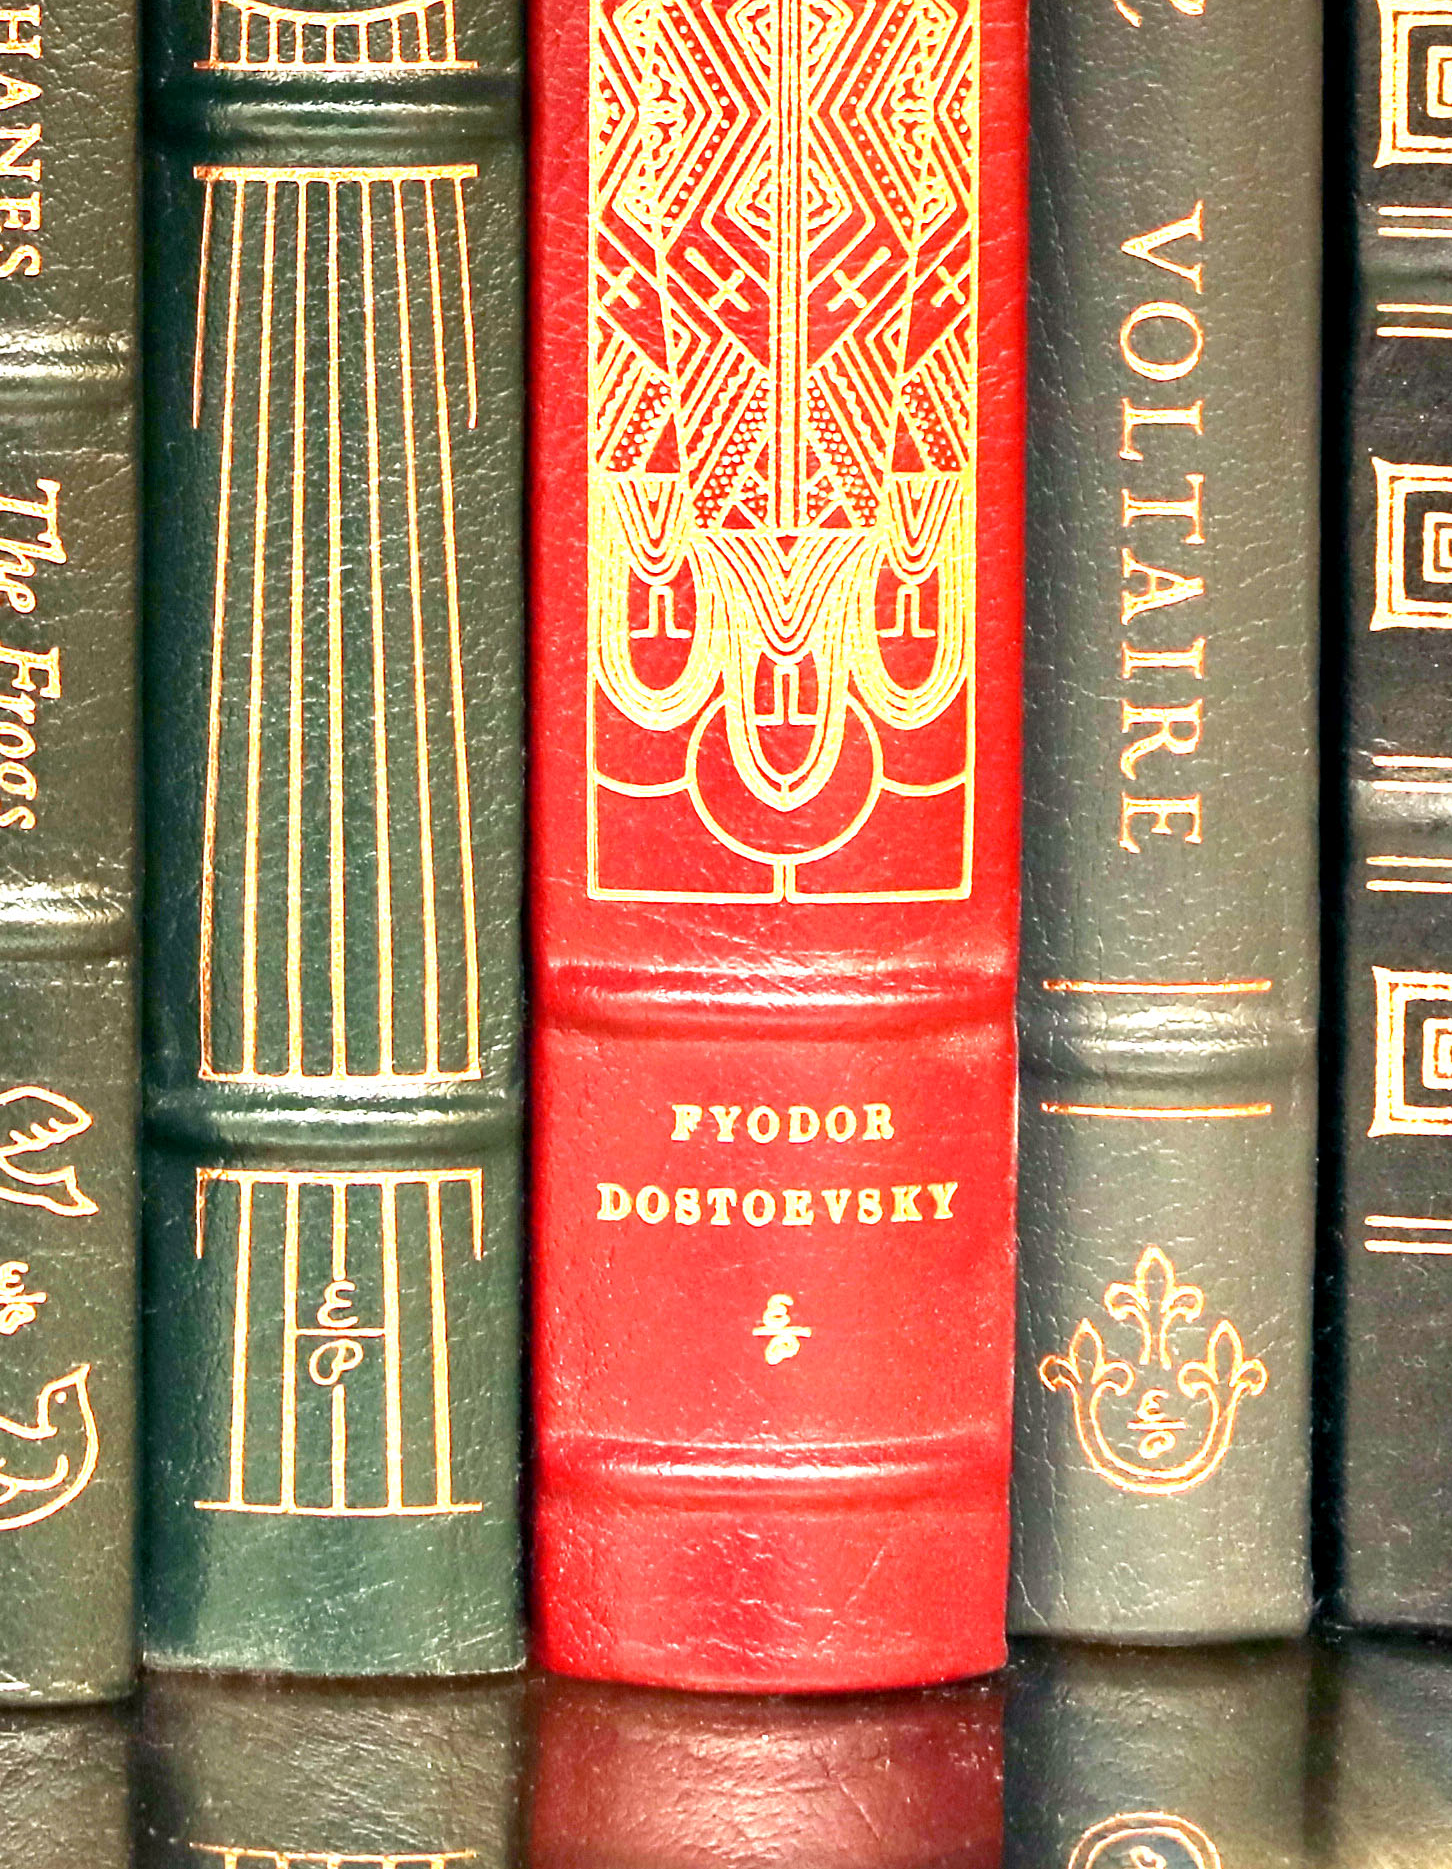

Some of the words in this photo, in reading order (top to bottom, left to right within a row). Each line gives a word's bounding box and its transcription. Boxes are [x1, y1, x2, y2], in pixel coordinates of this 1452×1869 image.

[1116, 198, 1208, 856] VOLTAIRE
[668, 1101, 897, 1146] FYODOR
[594, 1179, 961, 1229] DOSTOEVSKY
